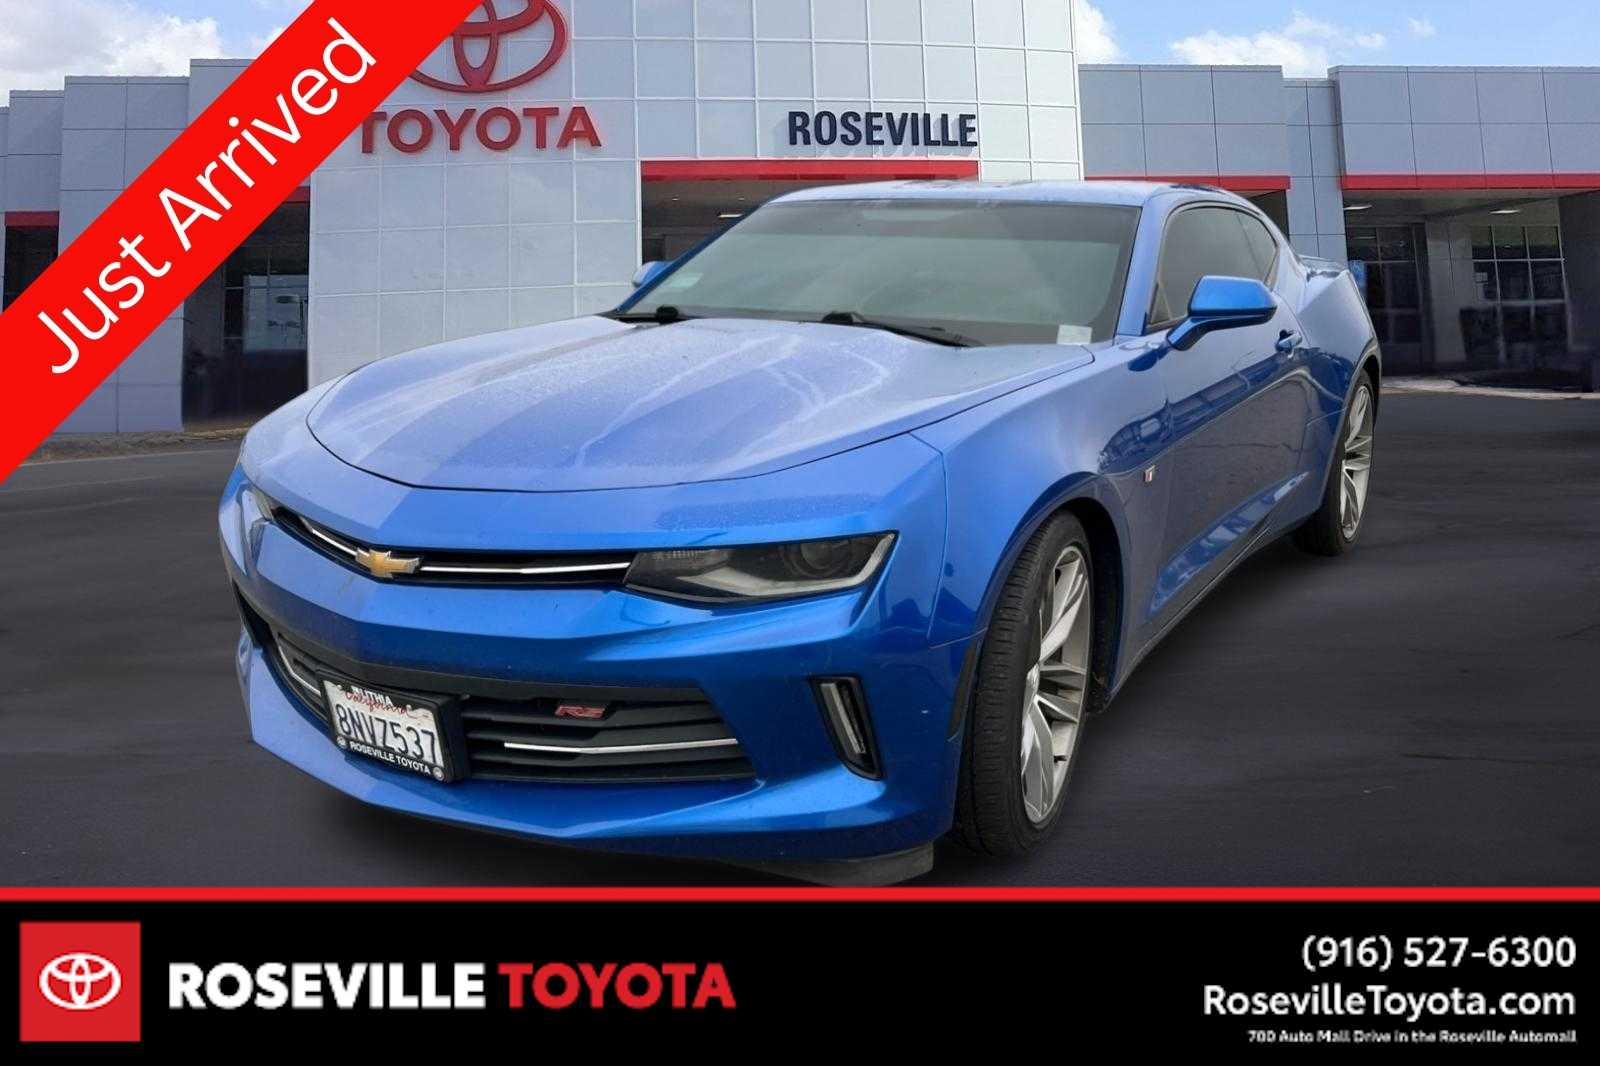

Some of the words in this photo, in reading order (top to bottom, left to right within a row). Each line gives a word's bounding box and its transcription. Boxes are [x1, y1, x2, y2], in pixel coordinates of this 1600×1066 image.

[361, 106, 602, 154] TOYOTA
[788, 110, 978, 147] ROSEVILLE
[555, 704, 605, 719] RS
[336, 703, 439, 764] 8NVZ537
[350, 742, 396, 763] ROSEVILLE
[397, 756, 431, 775] TOYOTA
